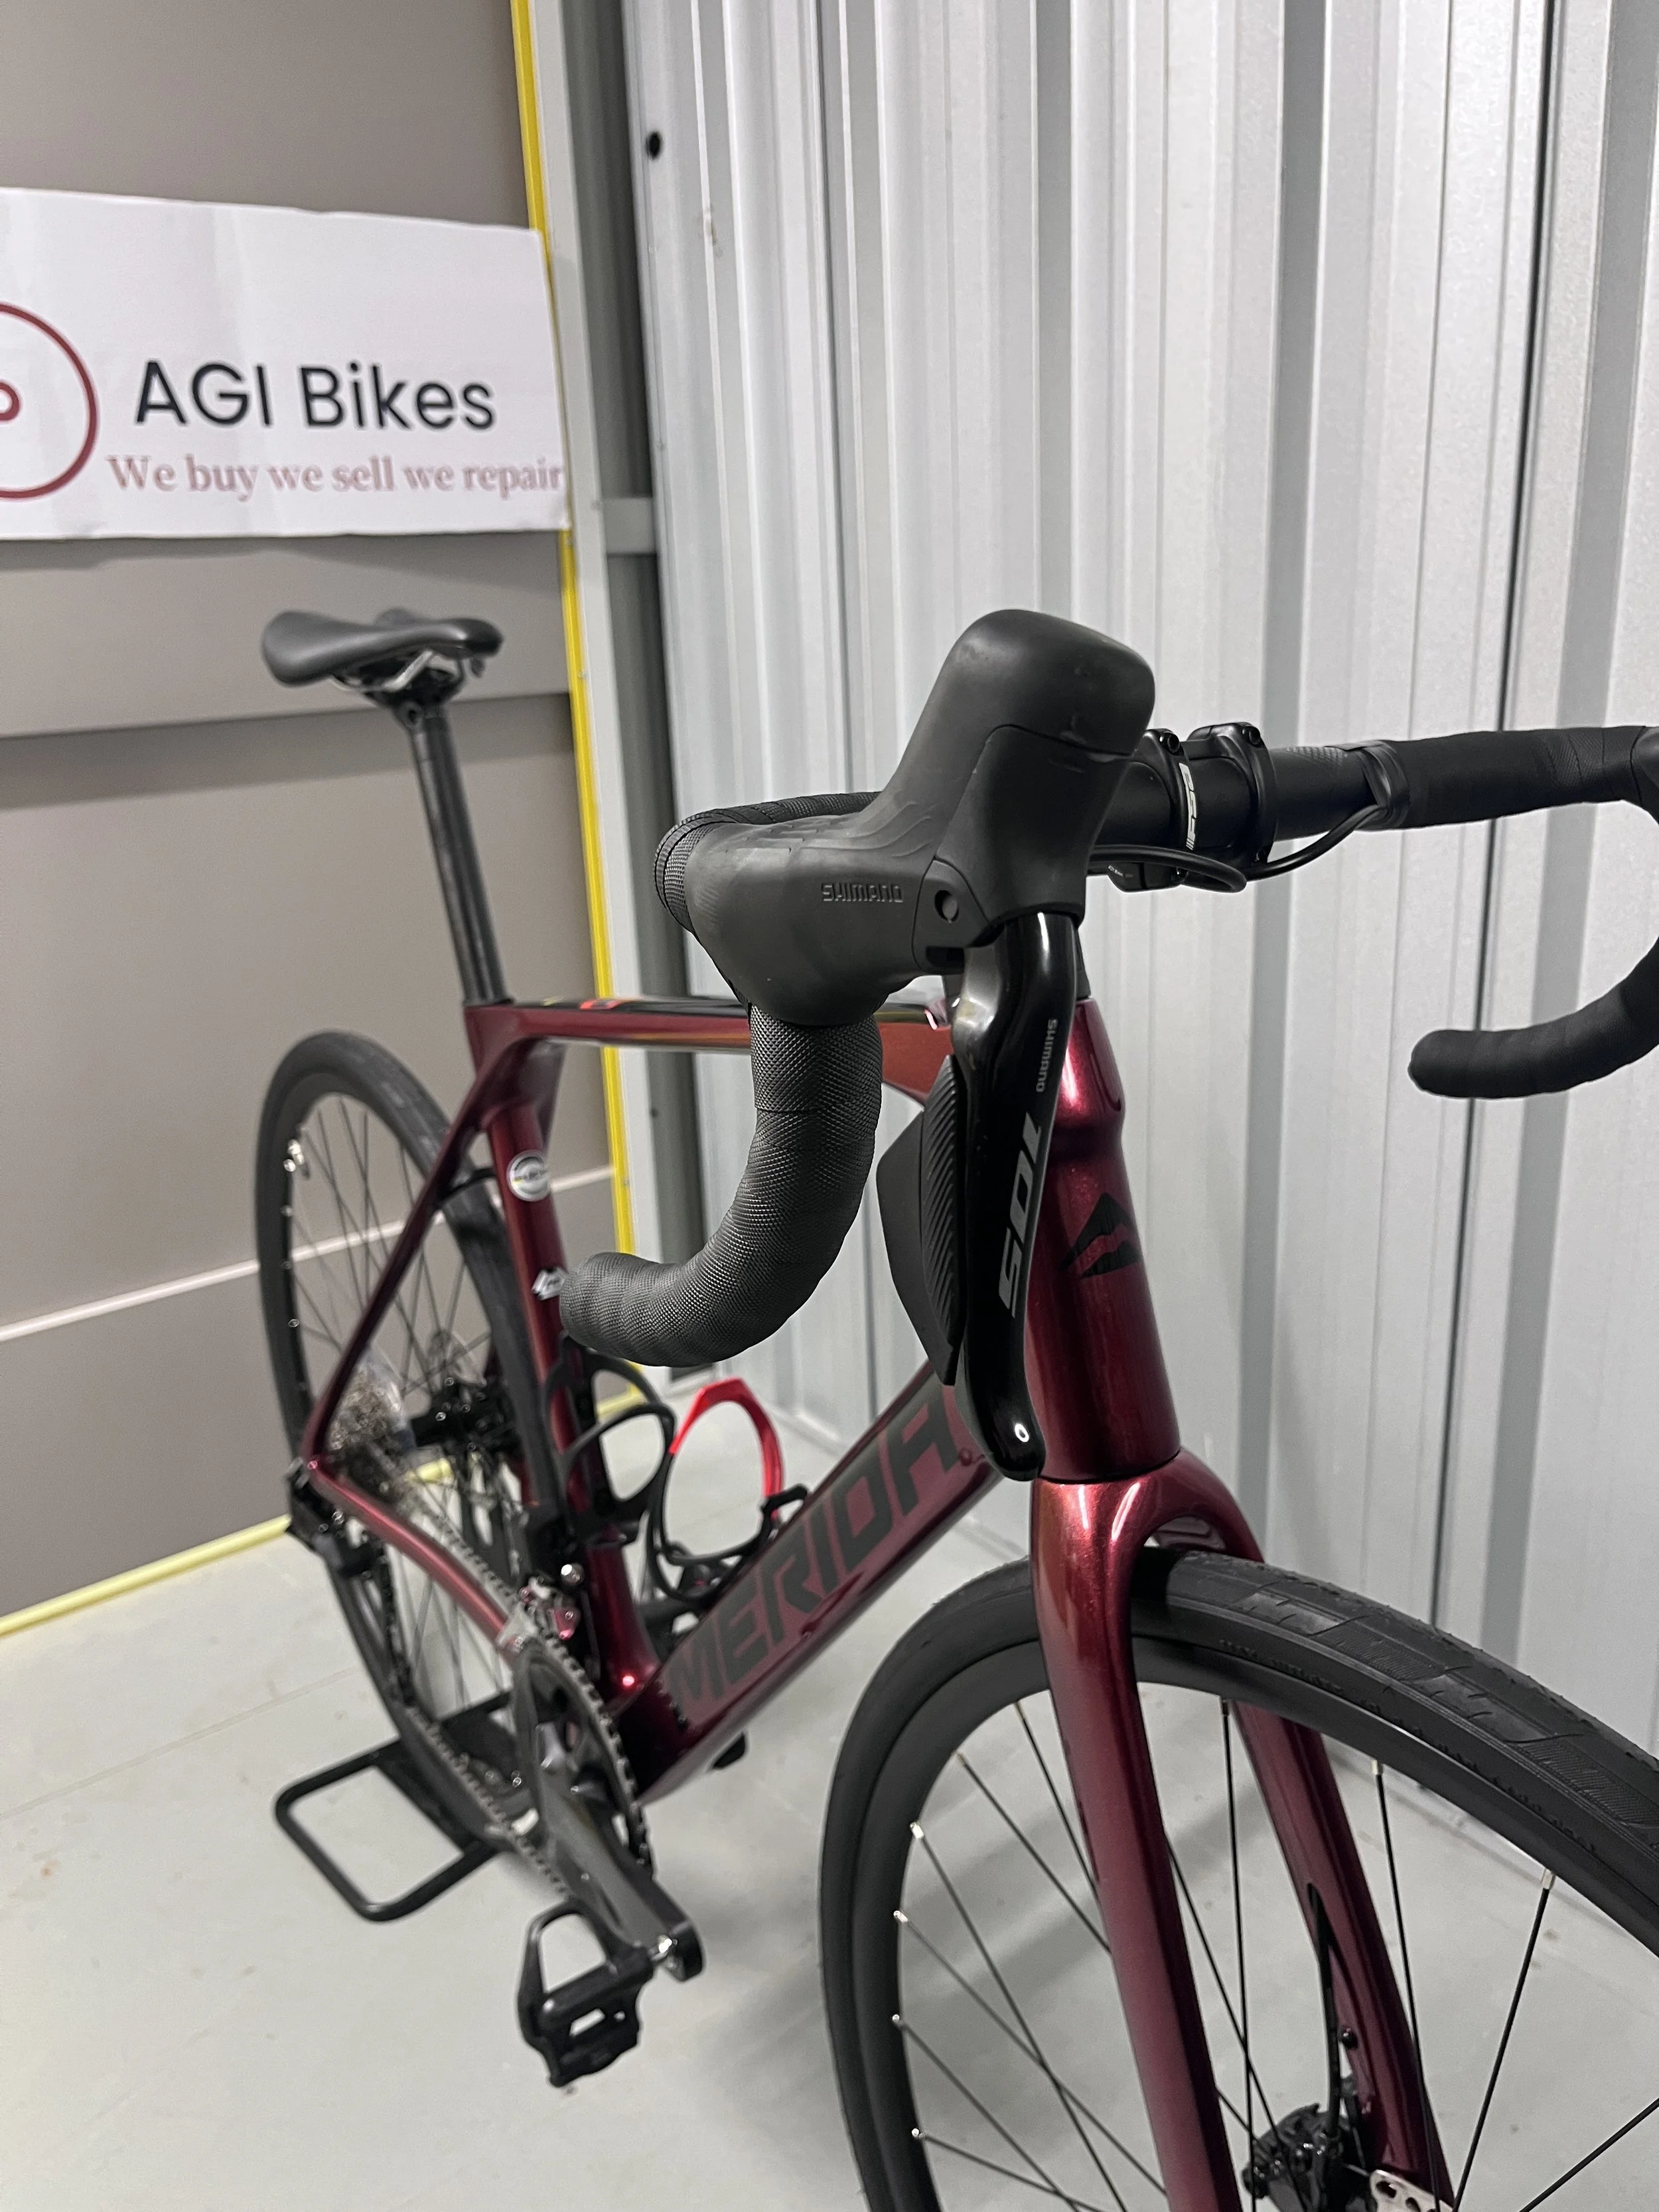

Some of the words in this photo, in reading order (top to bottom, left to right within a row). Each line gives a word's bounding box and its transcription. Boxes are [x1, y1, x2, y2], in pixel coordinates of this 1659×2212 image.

[136, 360, 271, 427] AGI
[300, 362, 493, 429] Bikes
[106, 455, 177, 492] We
[184, 453, 257, 502] buy
[267, 465, 324, 492] we
[332, 455, 396, 491] sell
[402, 465, 455, 492] we
[463, 456, 562, 500] repair
[821, 881, 904, 903] SHIMANO
[1035, 1019, 1058, 1092] SHIMANO
[998, 1111, 1042, 1319] 105
[665, 1376, 958, 1700] MERIDA
